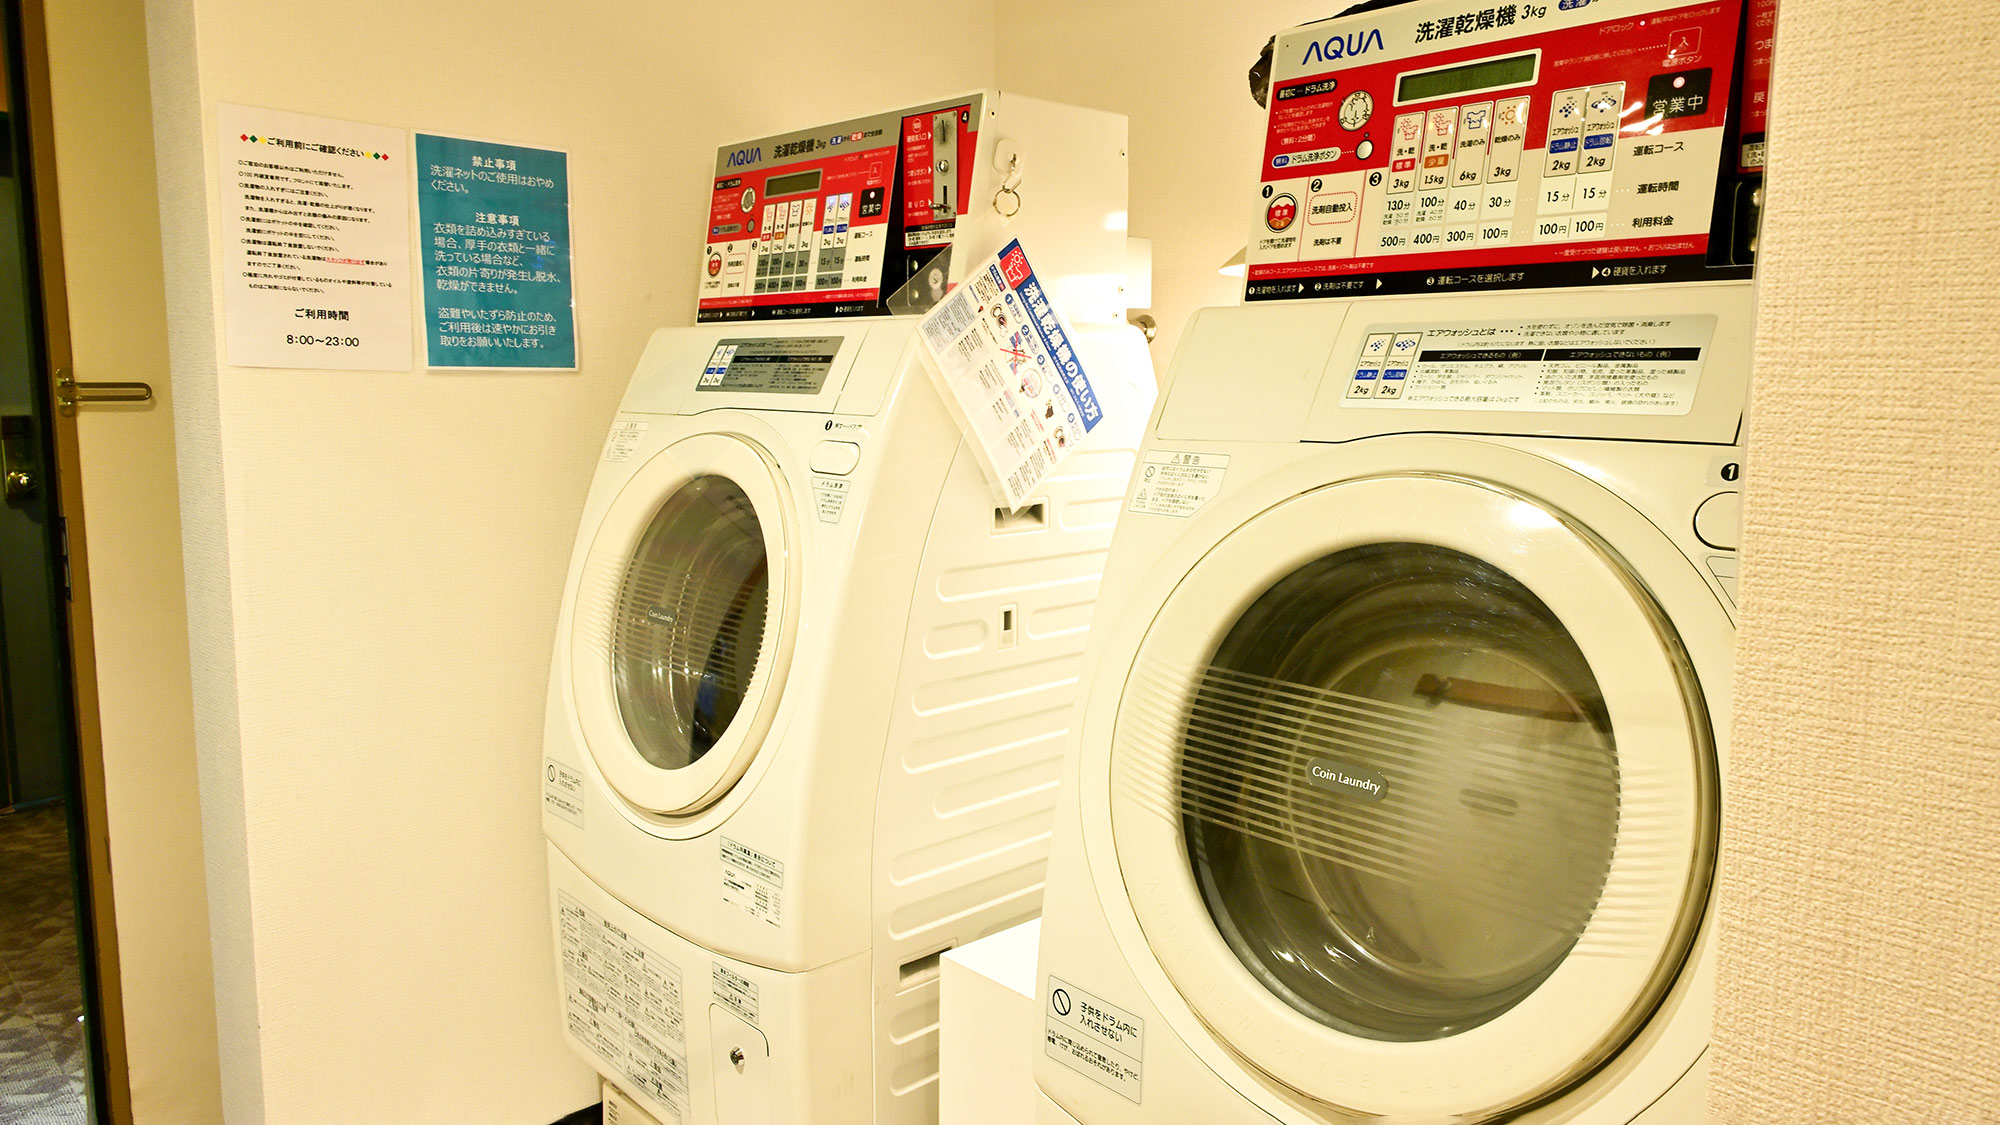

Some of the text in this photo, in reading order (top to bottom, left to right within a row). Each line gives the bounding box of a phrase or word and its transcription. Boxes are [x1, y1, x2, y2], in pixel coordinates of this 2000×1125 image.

[1415, 4, 1547, 44] 洗濯乾燥機 3kg
[1599, 22, 1634, 35] ドアロック
[1302, 29, 1384, 65] AQUA
[1679, 36, 1689, 47] 入
[1662, 54, 1702, 68] 電源ボタン
[1653, 95, 1703, 117] 営業中
[1551, 126, 1579, 136] エアウォッシュ
[1586, 121, 1615, 132] エアウォッシュ
[1459, 138, 1486, 149] 洗濯のみ
[1494, 134, 1521, 144] 乾燥のみ
[267, 137, 365, 157] ご利用前にご確認ください
[773, 139, 815, 159] 洗濯乾燥機
[1633, 141, 1684, 157] 運転コース
[472, 155, 517, 171] 禁止事項
[727, 146, 762, 168] AQUA
[1586, 156, 1606, 167] 2kg
[1551, 160, 1571, 171] 2kg
[430, 164, 554, 189] 洗濯ネットのご使用はおやめ
[1459, 170, 1477, 181] 6kg
[1493, 167, 1512, 178] 3kg
[430, 181, 469, 194] ください。
[1393, 179, 1410, 189] 3kg
[1637, 180, 1679, 195] 運転時間
[1546, 190, 1570, 203] 15分
[1582, 187, 1607, 200] 15分
[1312, 202, 1353, 215] 洗剤自動投入
[1387, 200, 1411, 212] 130分
[1420, 196, 1445, 208] 100分
[1453, 199, 1476, 211] 40分
[1488, 196, 1512, 208] 30分
[861, 203, 881, 215] 営業中
[475, 212, 520, 227] 注意事項
[1632, 215, 1674, 228] 利用料金
[433, 222, 550, 243] 衣類を詰め込みすぎている
[1539, 223, 1567, 236] 100円
[1575, 220, 1604, 233] 100円
[1413, 233, 1440, 245] 400円
[1446, 230, 1475, 243] 300円
[1481, 227, 1509, 240] 100円
[434, 236, 555, 256] 場合、厚手の衣類と一緒に
[1380, 235, 1406, 247] 500円
[434, 250, 524, 267] 洗っている場合など、
[435, 266, 561, 283] 衣類の片寄りが発生し脱水、
[1613, 265, 1667, 277] 硬貨を入れます
[1437, 271, 1525, 286] 運転コースを選択します
[436, 279, 518, 295] 乾燥ができません。
[294, 307, 350, 322] ご利用時間
[438, 307, 558, 323] 盗難やいたずら防止のため、
[439, 321, 556, 336] ご利用後は速やかにお引き
[1427, 329, 1496, 338] エアウォッシュとは
[440, 335, 545, 349] 取りをお願いいたします。
[1023, 282, 1099, 421] 洗濯乾燥機の使い方
[1353, 386, 1369, 395] 2kg
[1381, 386, 1397, 395] 2kg
[1312, 765, 1381, 795] Coin Laundry
[1080, 1001, 1138, 1038] 子供をドラム内に
[1080, 1015, 1123, 1042] 入れさせない
